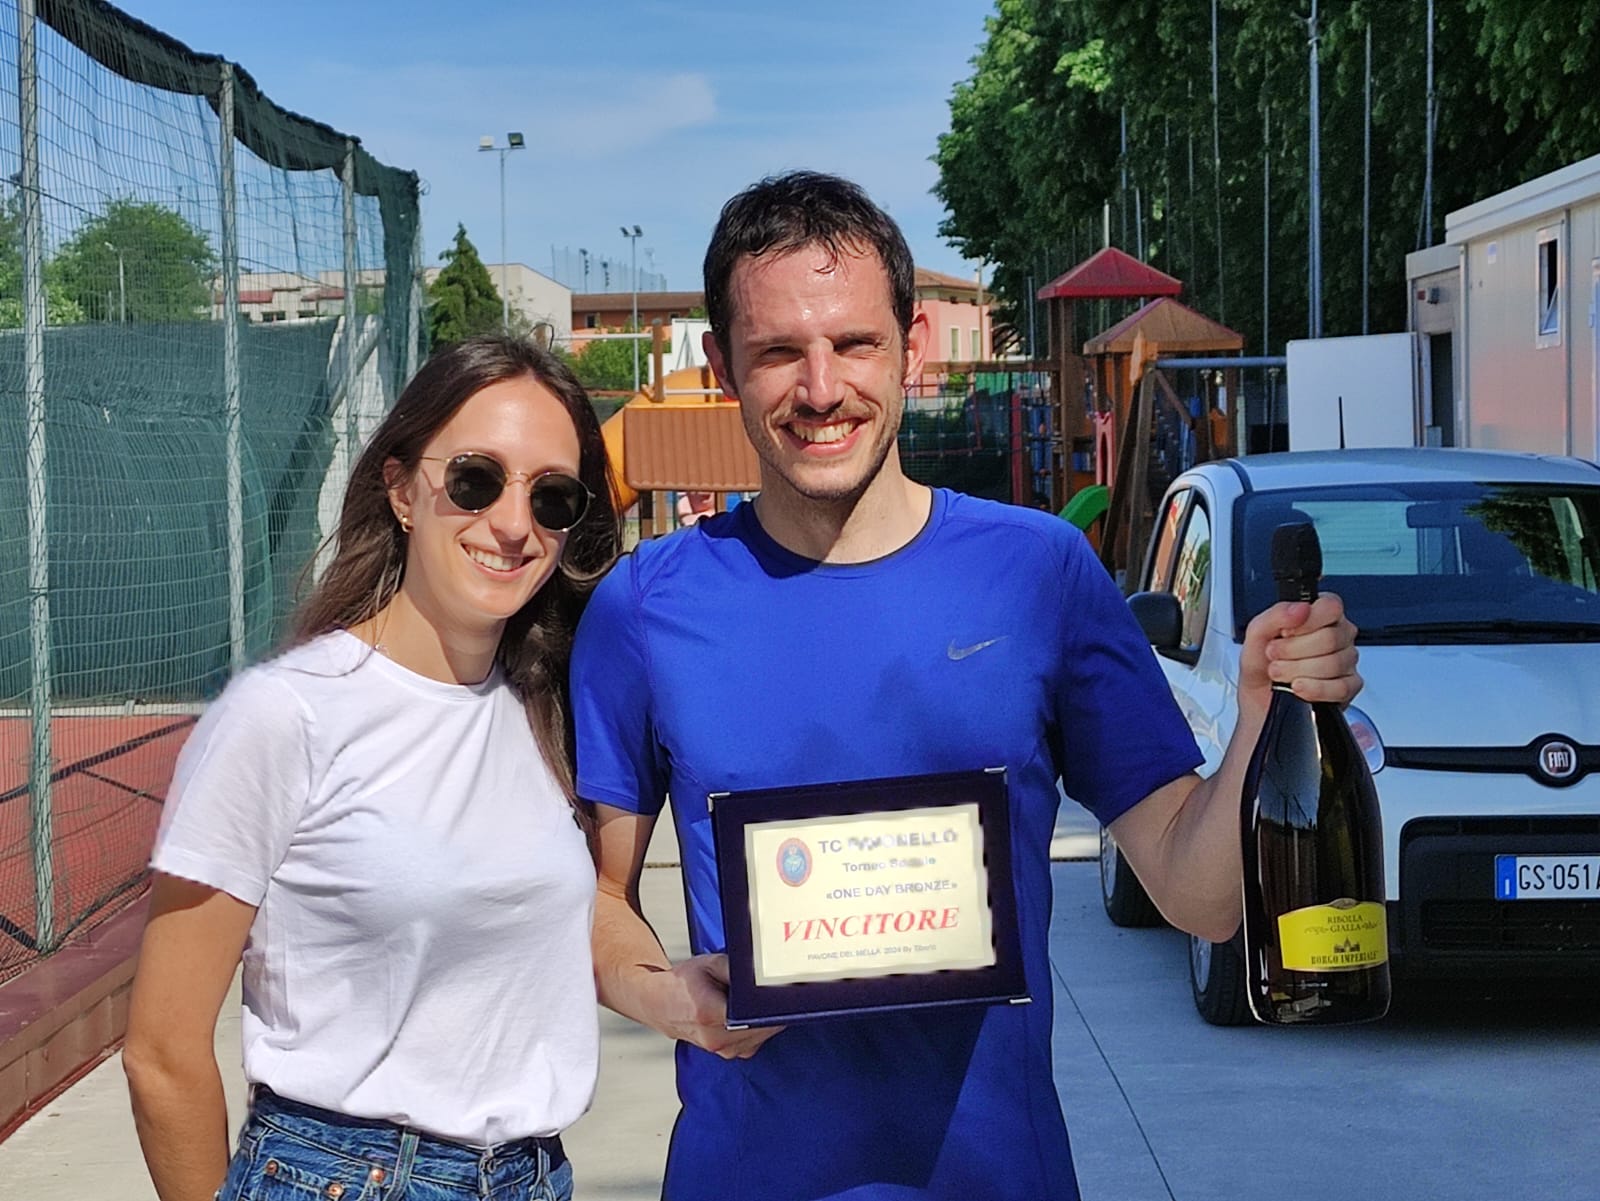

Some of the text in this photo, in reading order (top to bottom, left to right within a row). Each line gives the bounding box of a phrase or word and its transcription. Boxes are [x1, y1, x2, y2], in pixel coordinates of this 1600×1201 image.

[1548, 752, 1569, 767] FIAT
[818, 840, 842, 853] TC
[865, 885, 892, 897] DAY
[782, 907, 960, 943] VINCITORE
